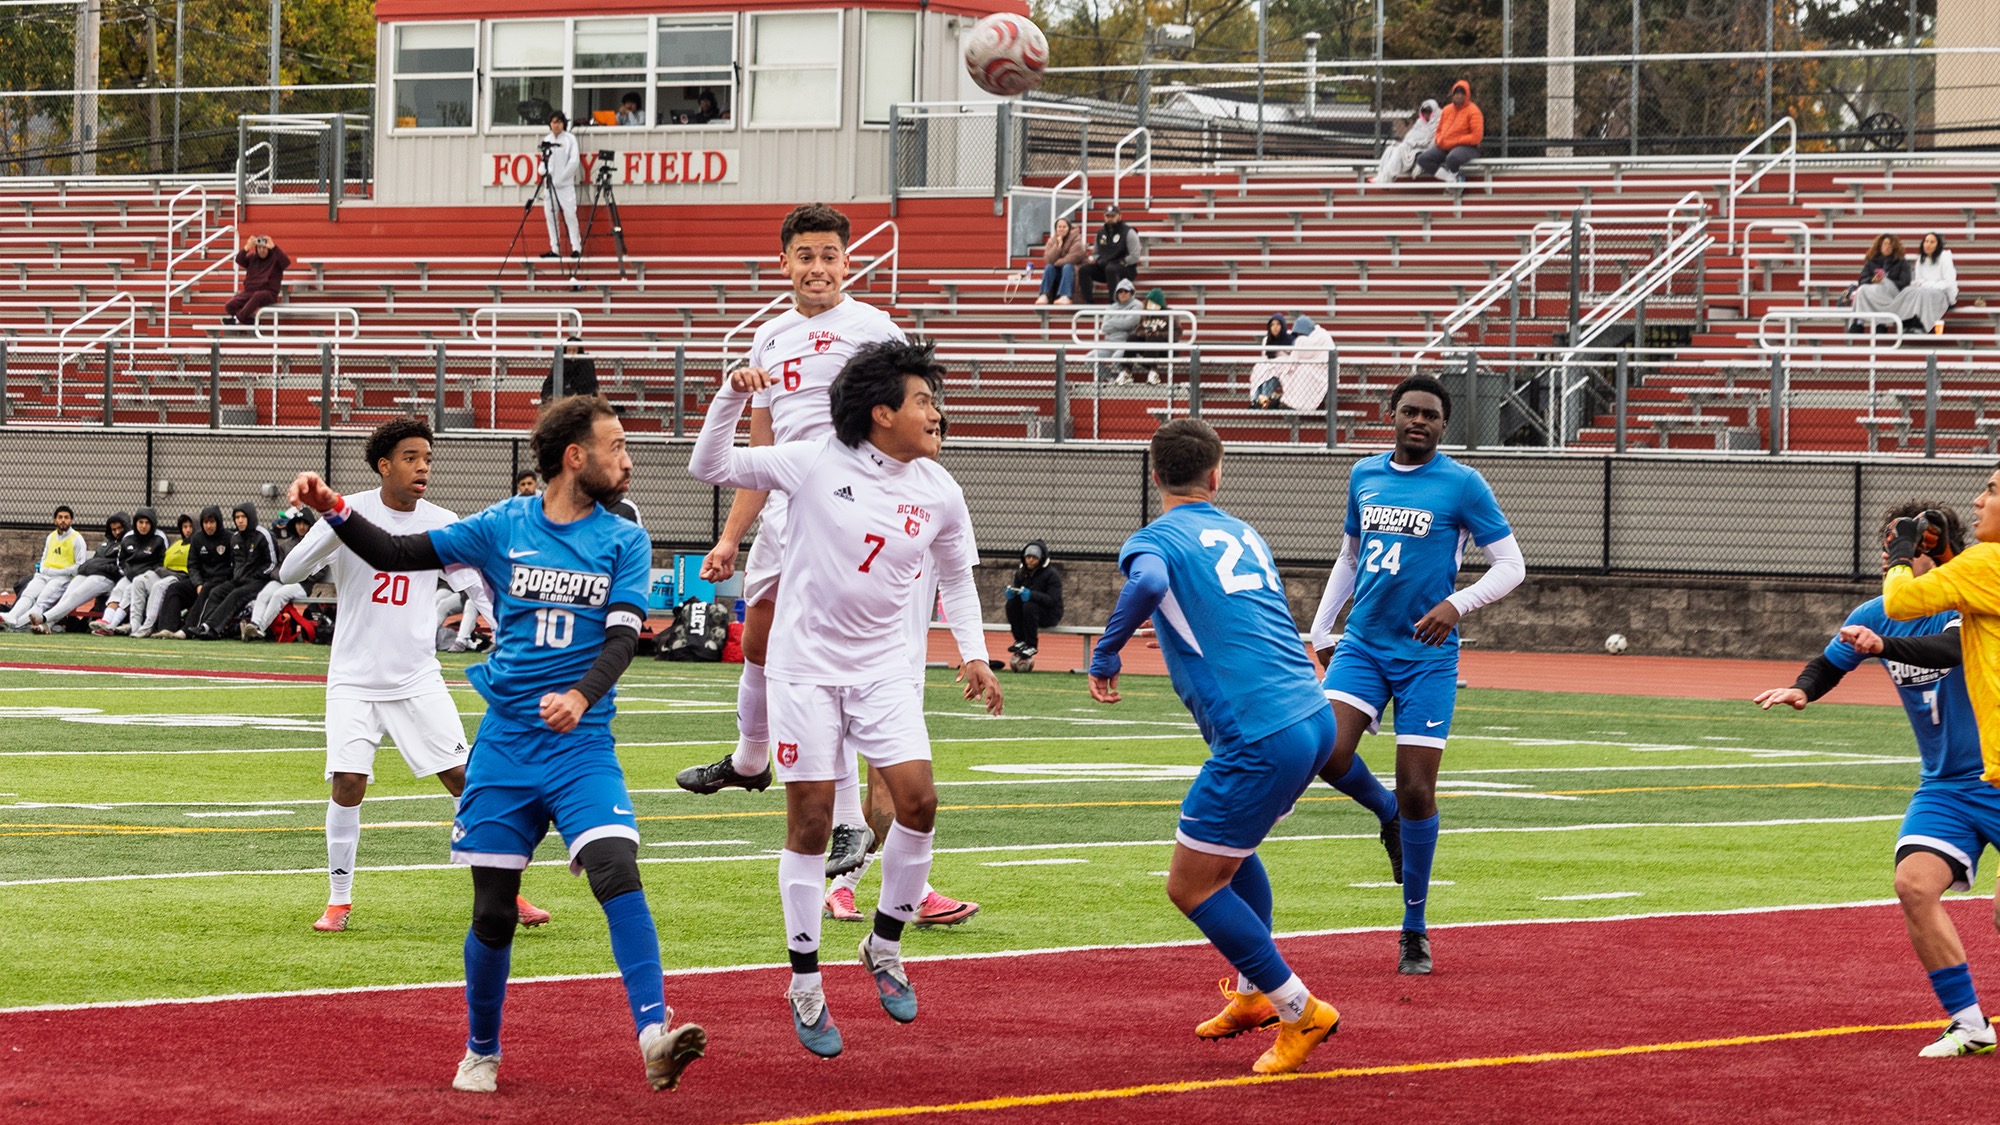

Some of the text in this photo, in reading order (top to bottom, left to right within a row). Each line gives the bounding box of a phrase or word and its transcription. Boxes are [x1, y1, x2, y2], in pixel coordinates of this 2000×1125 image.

[492, 151, 728, 186] FOY FIELD
[783, 357, 802, 392] 6
[897, 504, 931, 522] BCMSU
[1361, 506, 1433, 536] BOBCATS
[1378, 524, 1404, 533] ALBANY
[858, 533, 886, 574] 7
[1199, 528, 1279, 594] 21
[1366, 539, 1402, 575] 24
[371, 572, 411, 607] 20
[510, 567, 611, 607] BOBCATS
[539, 592, 575, 604] ALBANY
[535, 608, 575, 649] 10
[1922, 690, 1941, 725] 7
